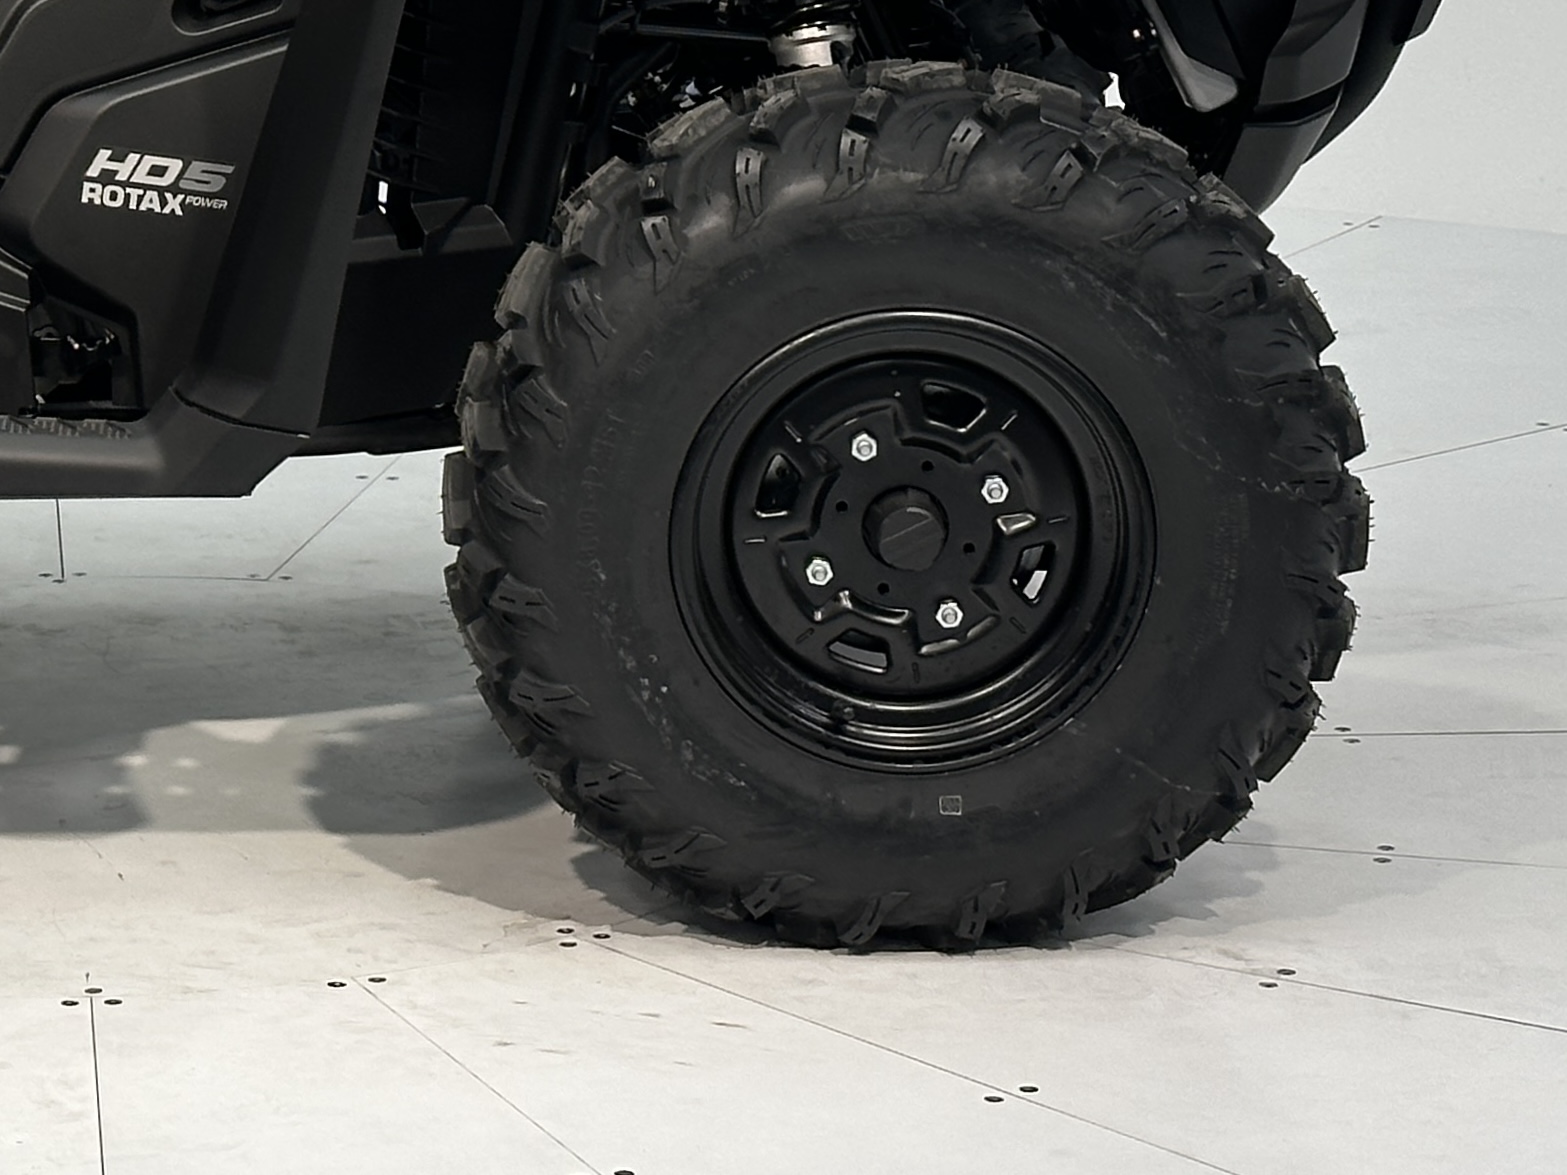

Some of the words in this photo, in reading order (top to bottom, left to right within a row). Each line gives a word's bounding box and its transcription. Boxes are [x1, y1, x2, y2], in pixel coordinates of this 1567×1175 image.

[84, 148, 236, 193] HD5
[80, 181, 186, 217] ROTAX
[184, 195, 229, 211] POWER
